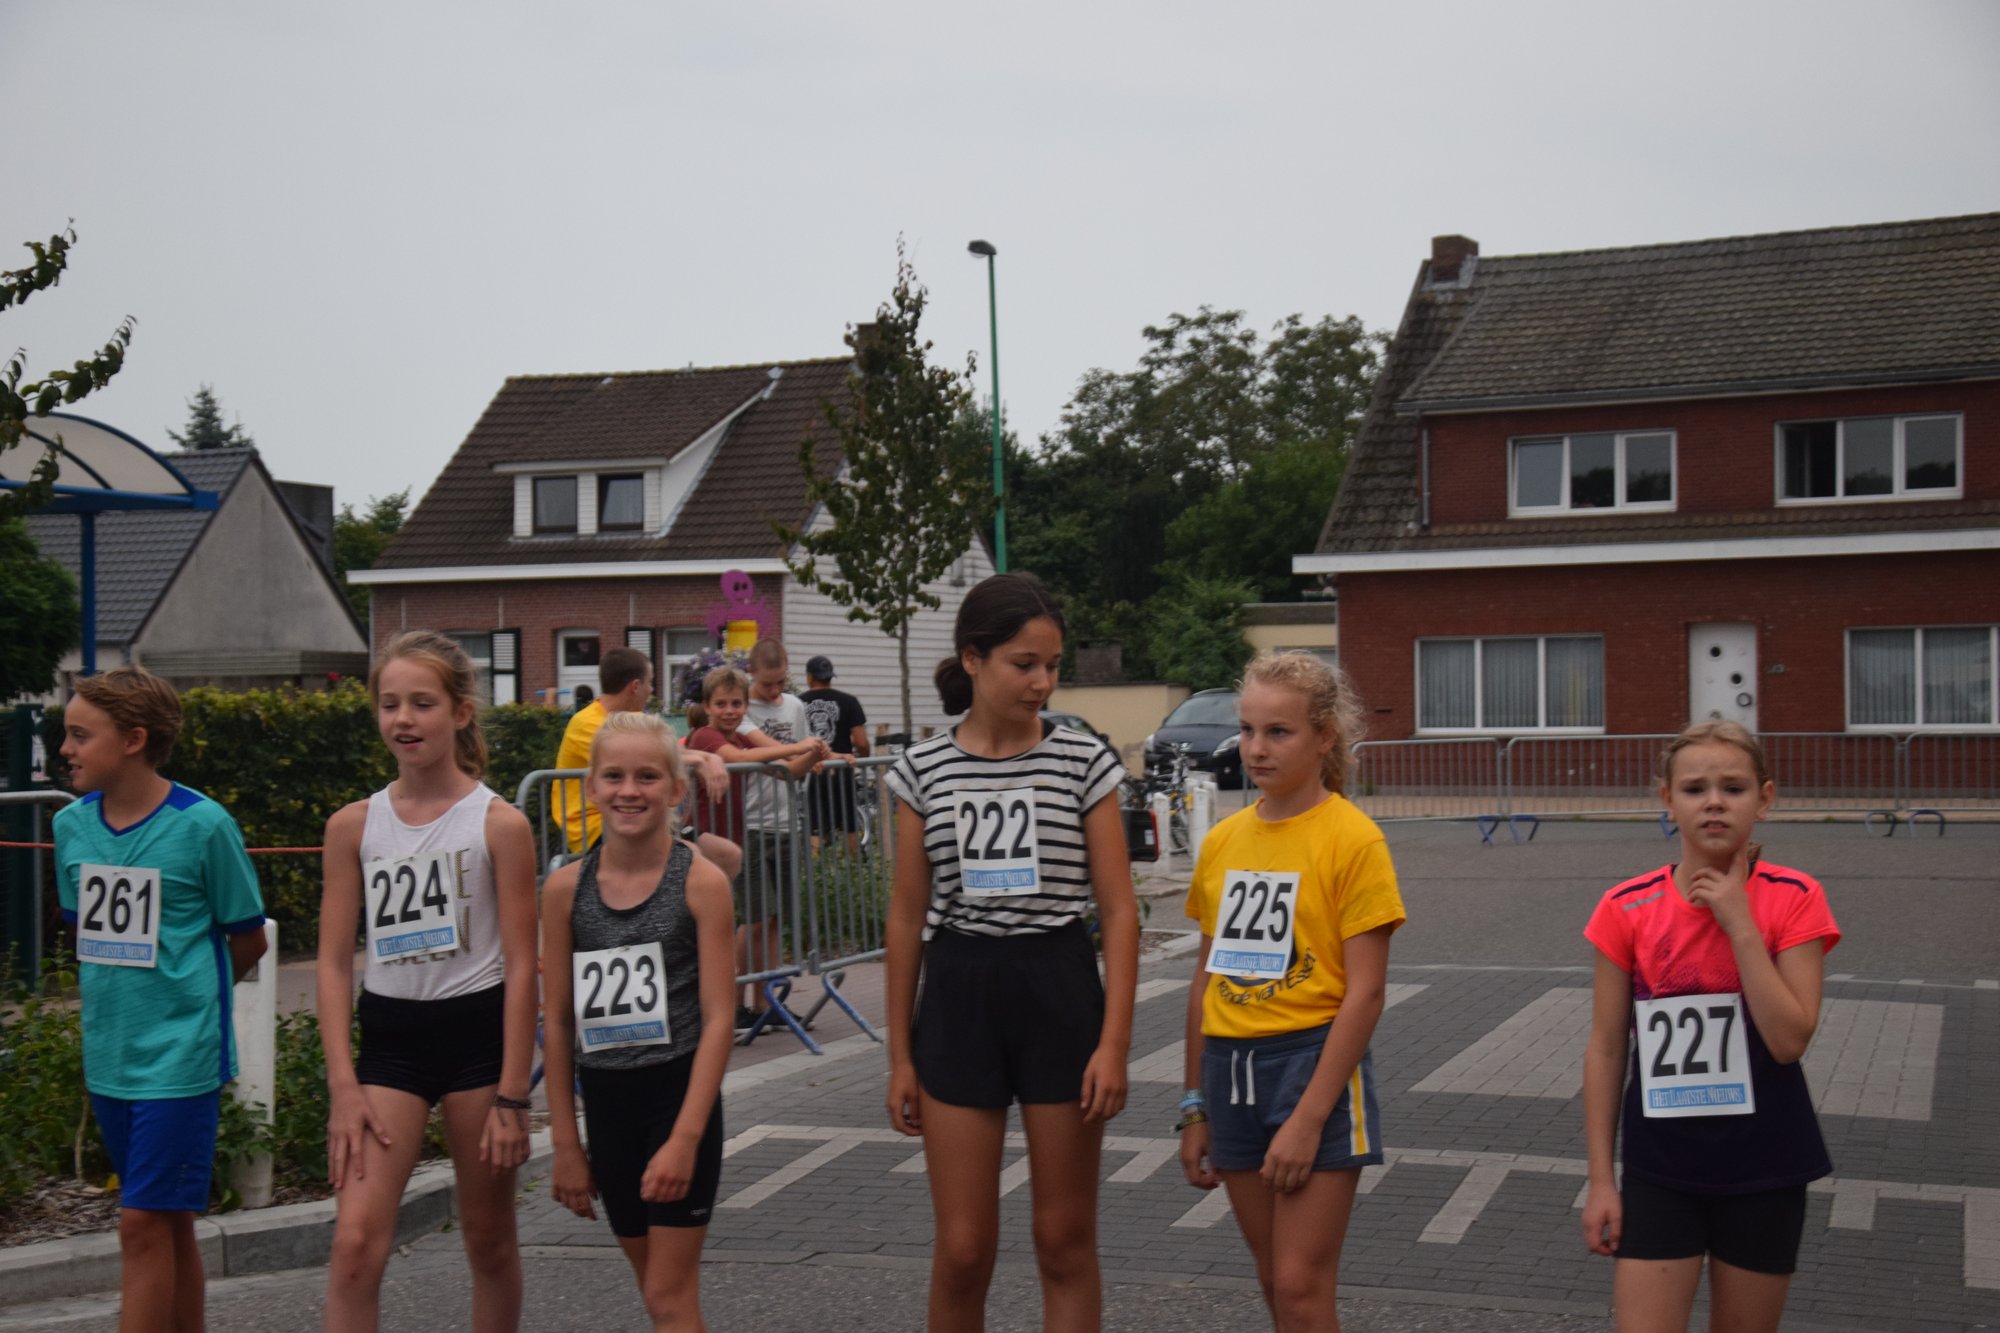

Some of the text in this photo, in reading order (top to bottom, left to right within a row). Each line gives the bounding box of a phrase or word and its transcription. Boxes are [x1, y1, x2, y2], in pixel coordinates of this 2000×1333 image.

[960, 799, 1031, 860] 222
[83, 875, 151, 935] 261
[371, 859, 448, 928] 224
[1222, 880, 1292, 942] 225
[582, 954, 658, 1019] 223
[1648, 1005, 1736, 1078] 227
